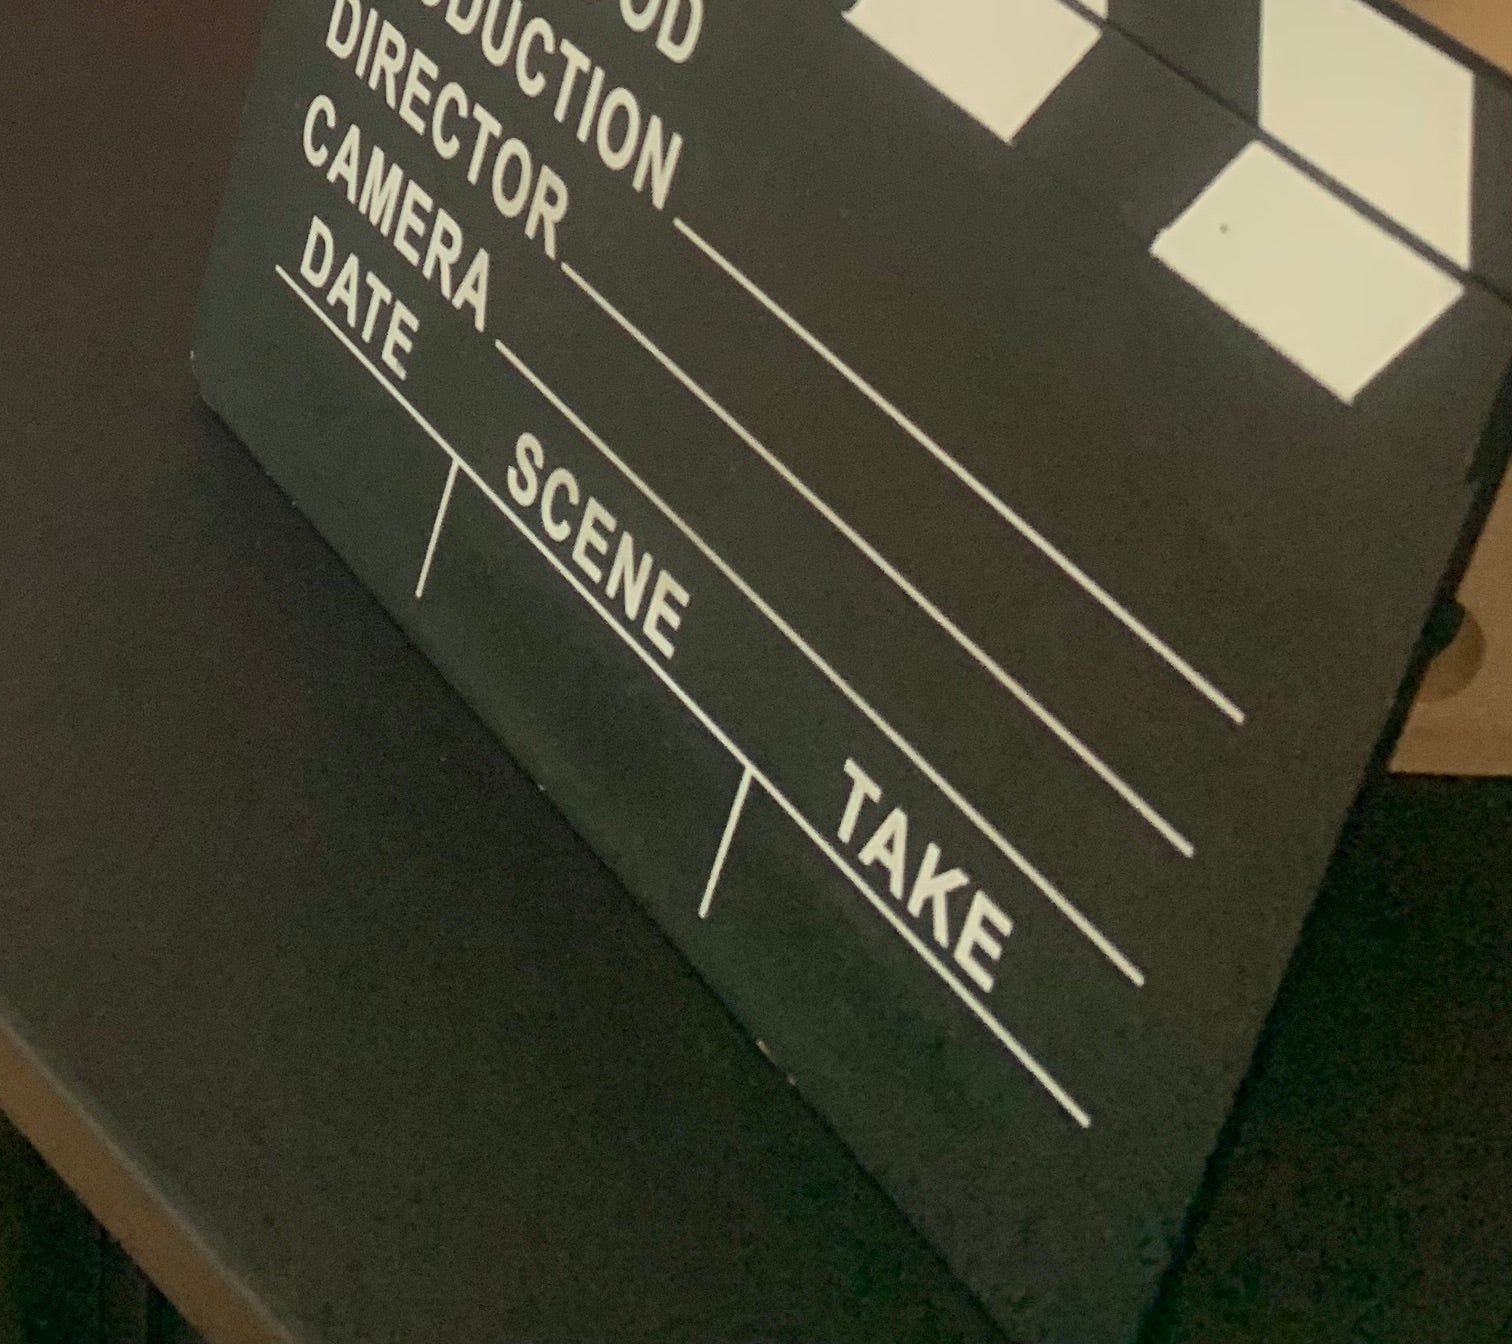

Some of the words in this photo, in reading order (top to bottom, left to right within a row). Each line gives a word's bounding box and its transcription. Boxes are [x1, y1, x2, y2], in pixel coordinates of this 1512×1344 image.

[299, 214, 420, 381] DATE
[302, 94, 489, 333] CAMERA
[506, 431, 691, 660] SCENE
[835, 756, 1014, 994] TAKE
